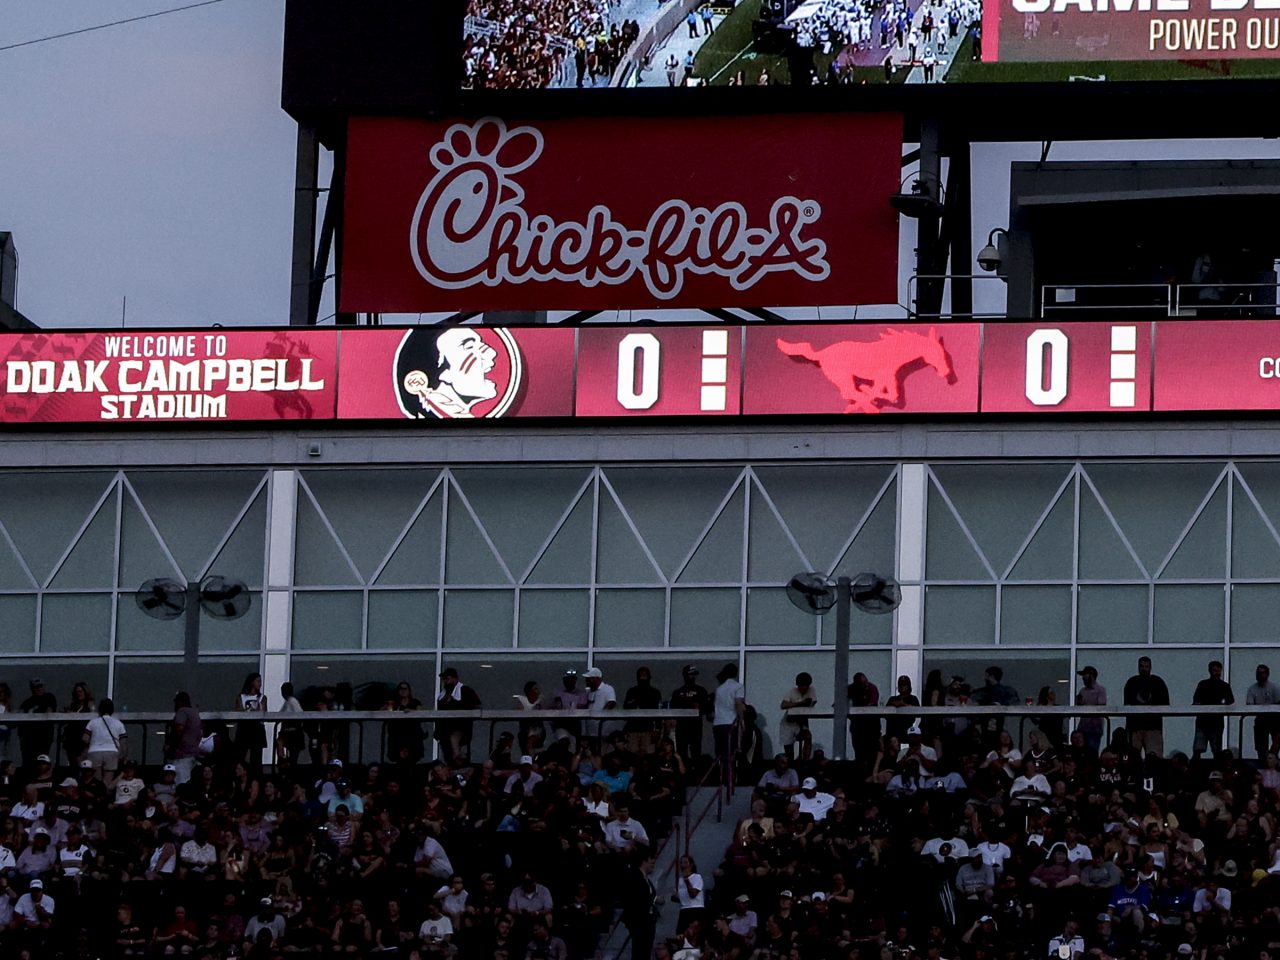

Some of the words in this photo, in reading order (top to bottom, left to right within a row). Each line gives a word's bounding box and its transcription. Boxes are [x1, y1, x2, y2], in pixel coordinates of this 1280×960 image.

[1149, 18, 1237, 51] POWER
[410, 116, 831, 300] Chick-fil-A
[104, 335, 196, 358] WELCOME
[204, 335, 227, 357] TO
[6, 359, 104, 393] DOAK
[118, 357, 325, 393] CAMPBELL
[617, 333, 660, 409] 0
[1025, 328, 1068, 405] 0
[100, 394, 227, 419] STADIUM
